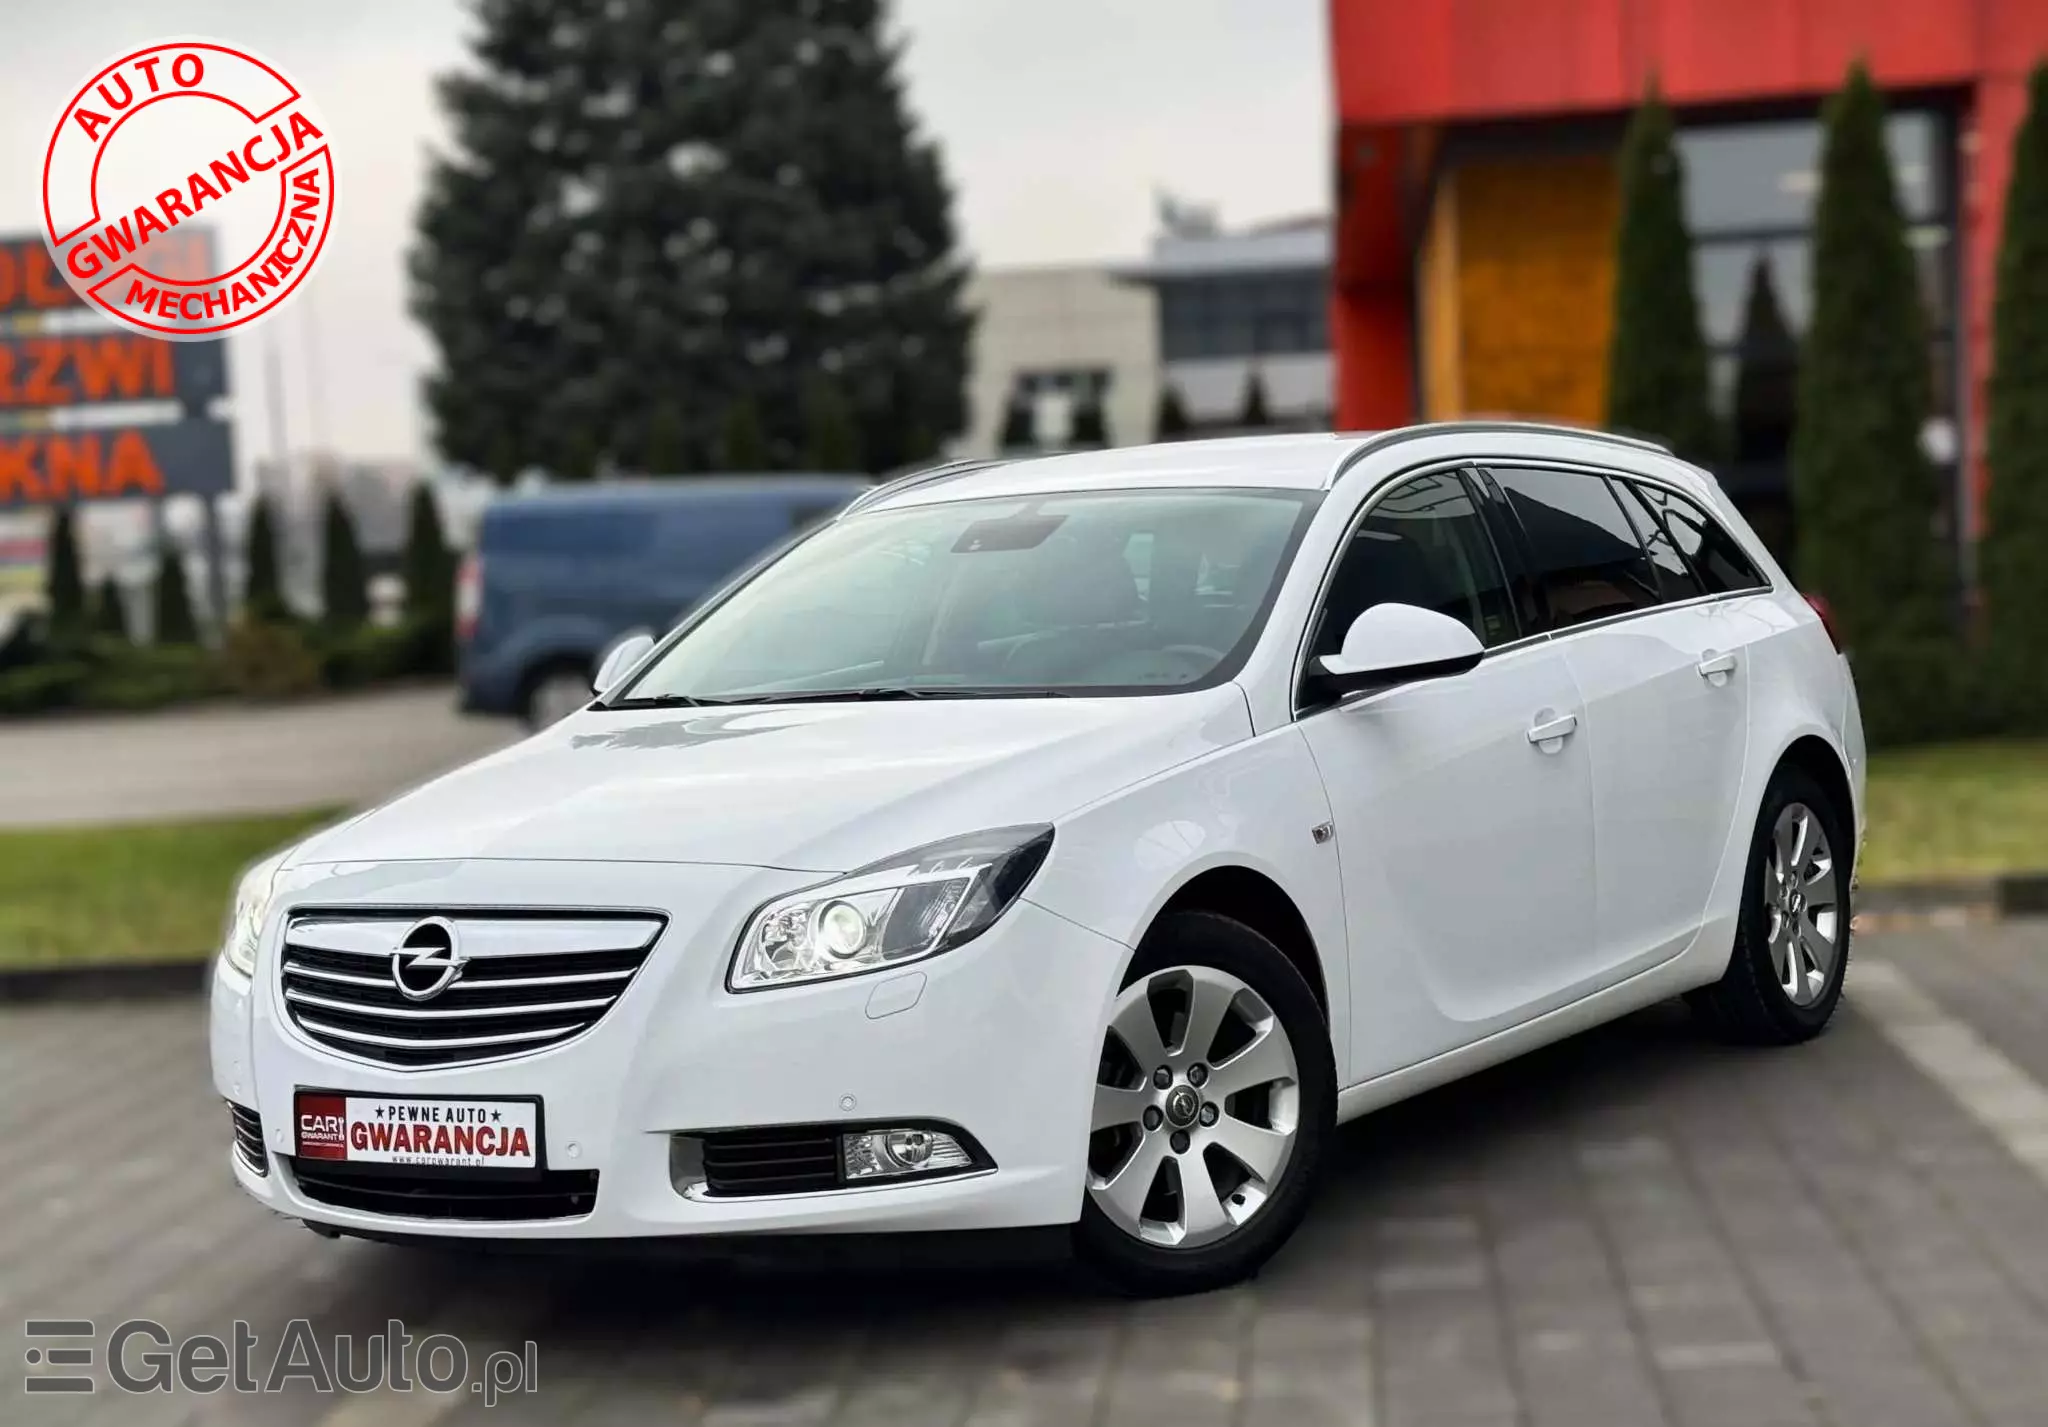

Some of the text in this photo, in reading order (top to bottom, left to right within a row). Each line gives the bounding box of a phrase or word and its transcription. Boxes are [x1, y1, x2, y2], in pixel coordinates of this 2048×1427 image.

[301, 1114, 338, 1132] CAR
[388, 1105, 487, 1124] PEWNE AUTO
[350, 1121, 531, 1157] GWARANCJA
